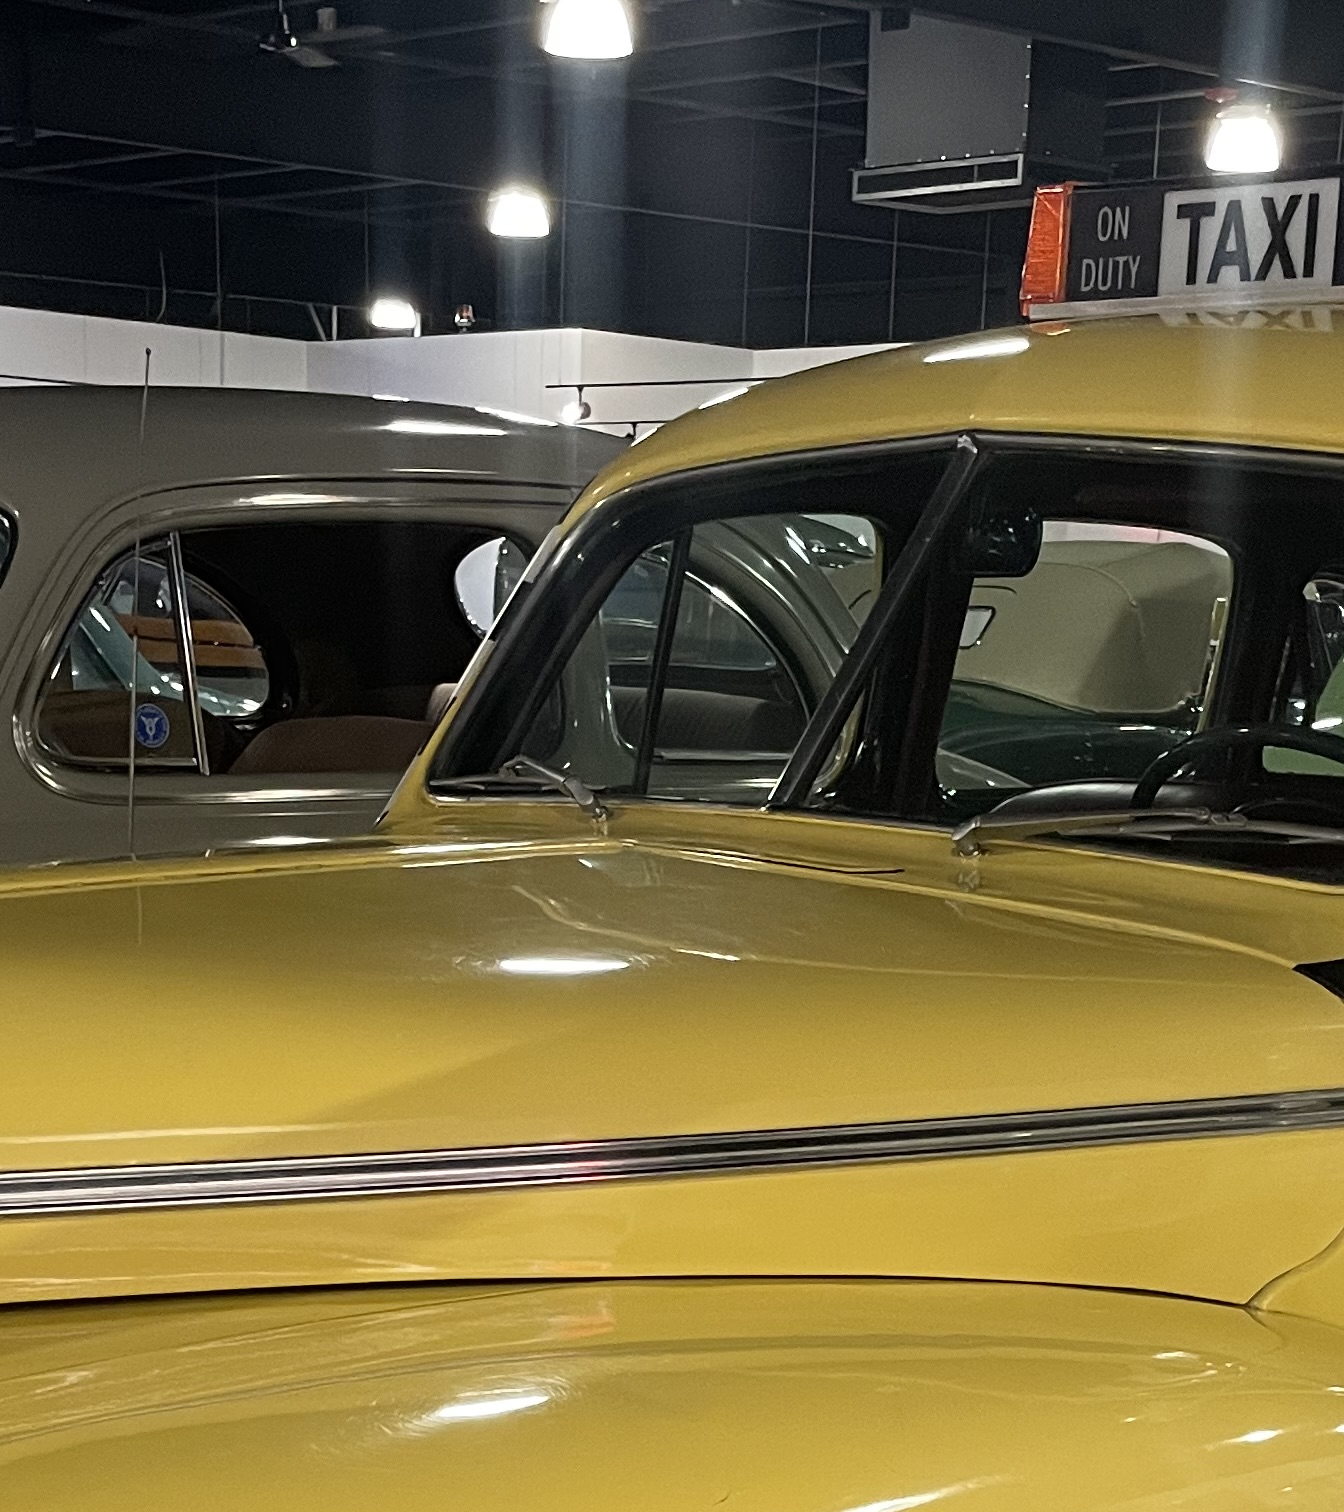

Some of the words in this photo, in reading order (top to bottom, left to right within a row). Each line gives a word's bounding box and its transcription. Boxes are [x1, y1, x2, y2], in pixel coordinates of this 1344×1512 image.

[1096, 205, 1129, 243] ON
[1175, 193, 1321, 287] TAXI
[1080, 255, 1141, 293] DUTY
